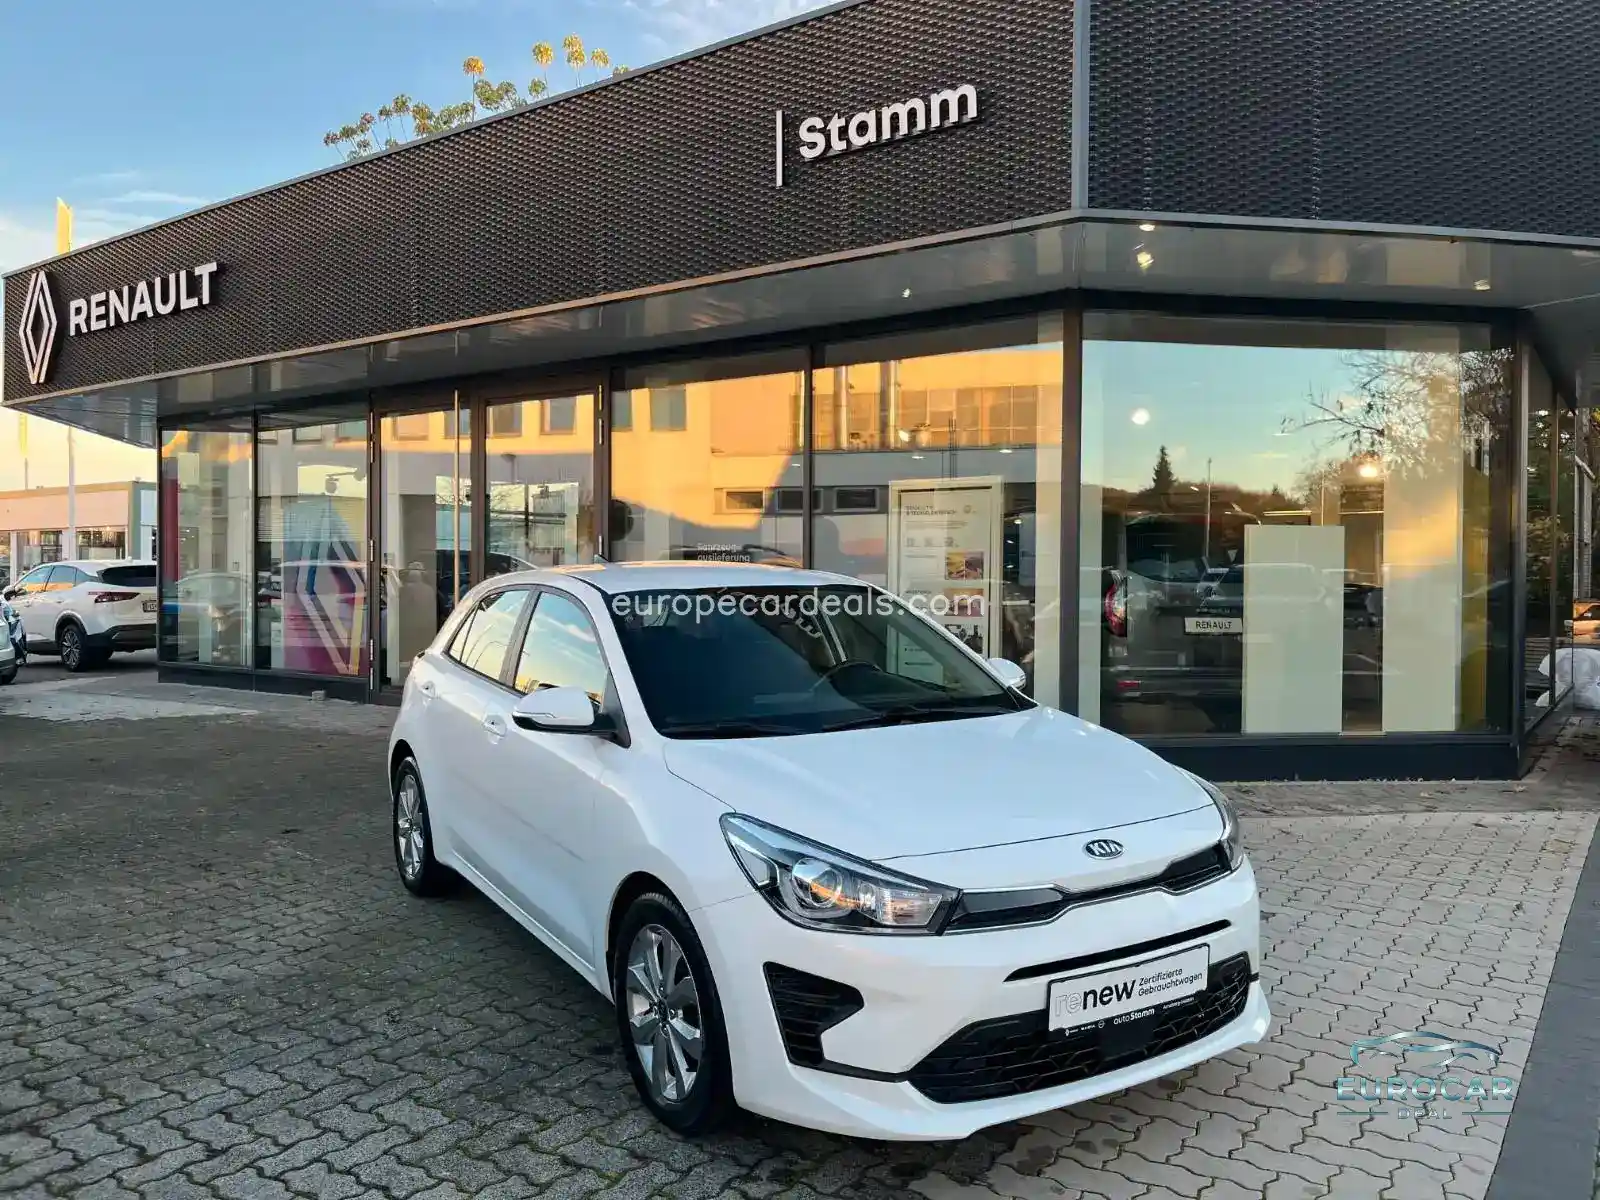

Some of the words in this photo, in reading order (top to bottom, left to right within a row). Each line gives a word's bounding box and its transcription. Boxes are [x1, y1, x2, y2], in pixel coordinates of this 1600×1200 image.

[798, 83, 978, 160] Stamm
[69, 261, 218, 336] RENAULT
[1195, 620, 1233, 630] RENAULT
[1087, 840, 1122, 856] KIA
[1138, 968, 1183, 987] Zertifizierte
[1138, 972, 1203, 997] Gebrauchtwagen
[1054, 979, 1137, 1017] renew
